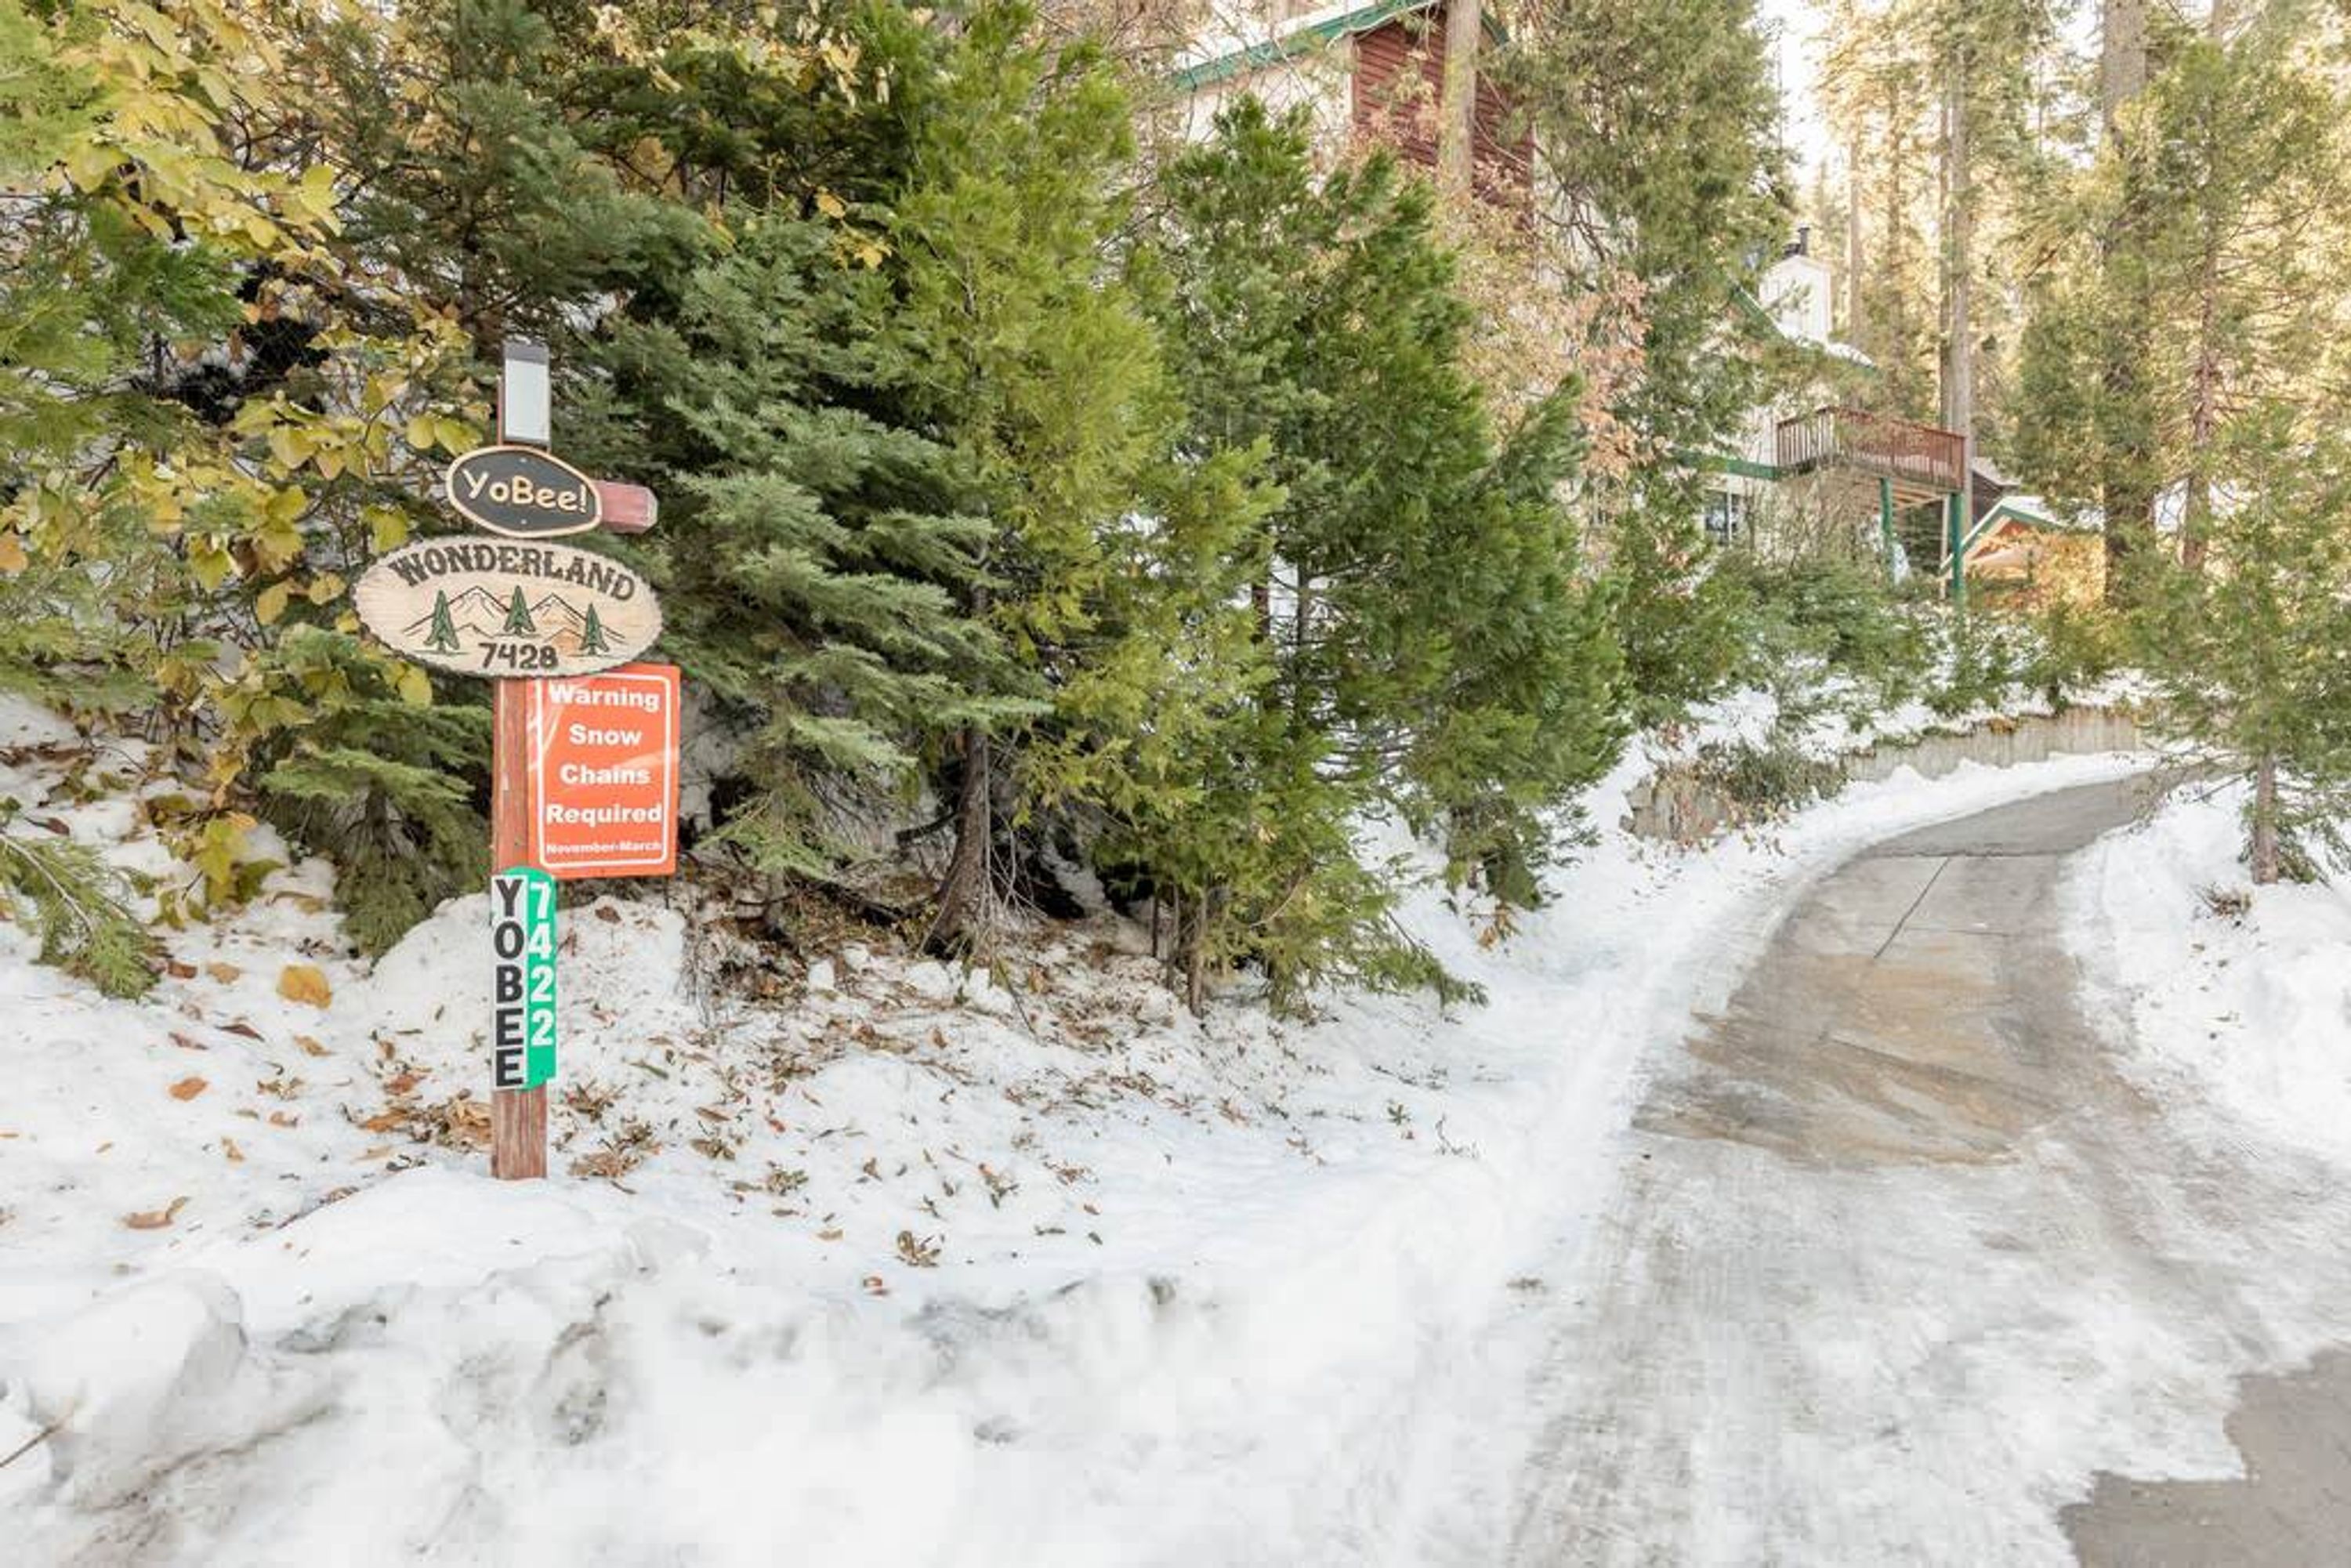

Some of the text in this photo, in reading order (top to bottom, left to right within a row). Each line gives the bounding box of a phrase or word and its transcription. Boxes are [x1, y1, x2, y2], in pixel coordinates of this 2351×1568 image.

[462, 468, 588, 513] YoBee!
[389, 544, 636, 601] WONDERLAND
[478, 643, 559, 669] 7428
[549, 683, 660, 712] Warning
[569, 723, 643, 745] Snow
[560, 764, 651, 784] Chains
[546, 803, 662, 827] Required
[527, 882, 554, 1047] 7422
[494, 878, 524, 1087] YOBEE
